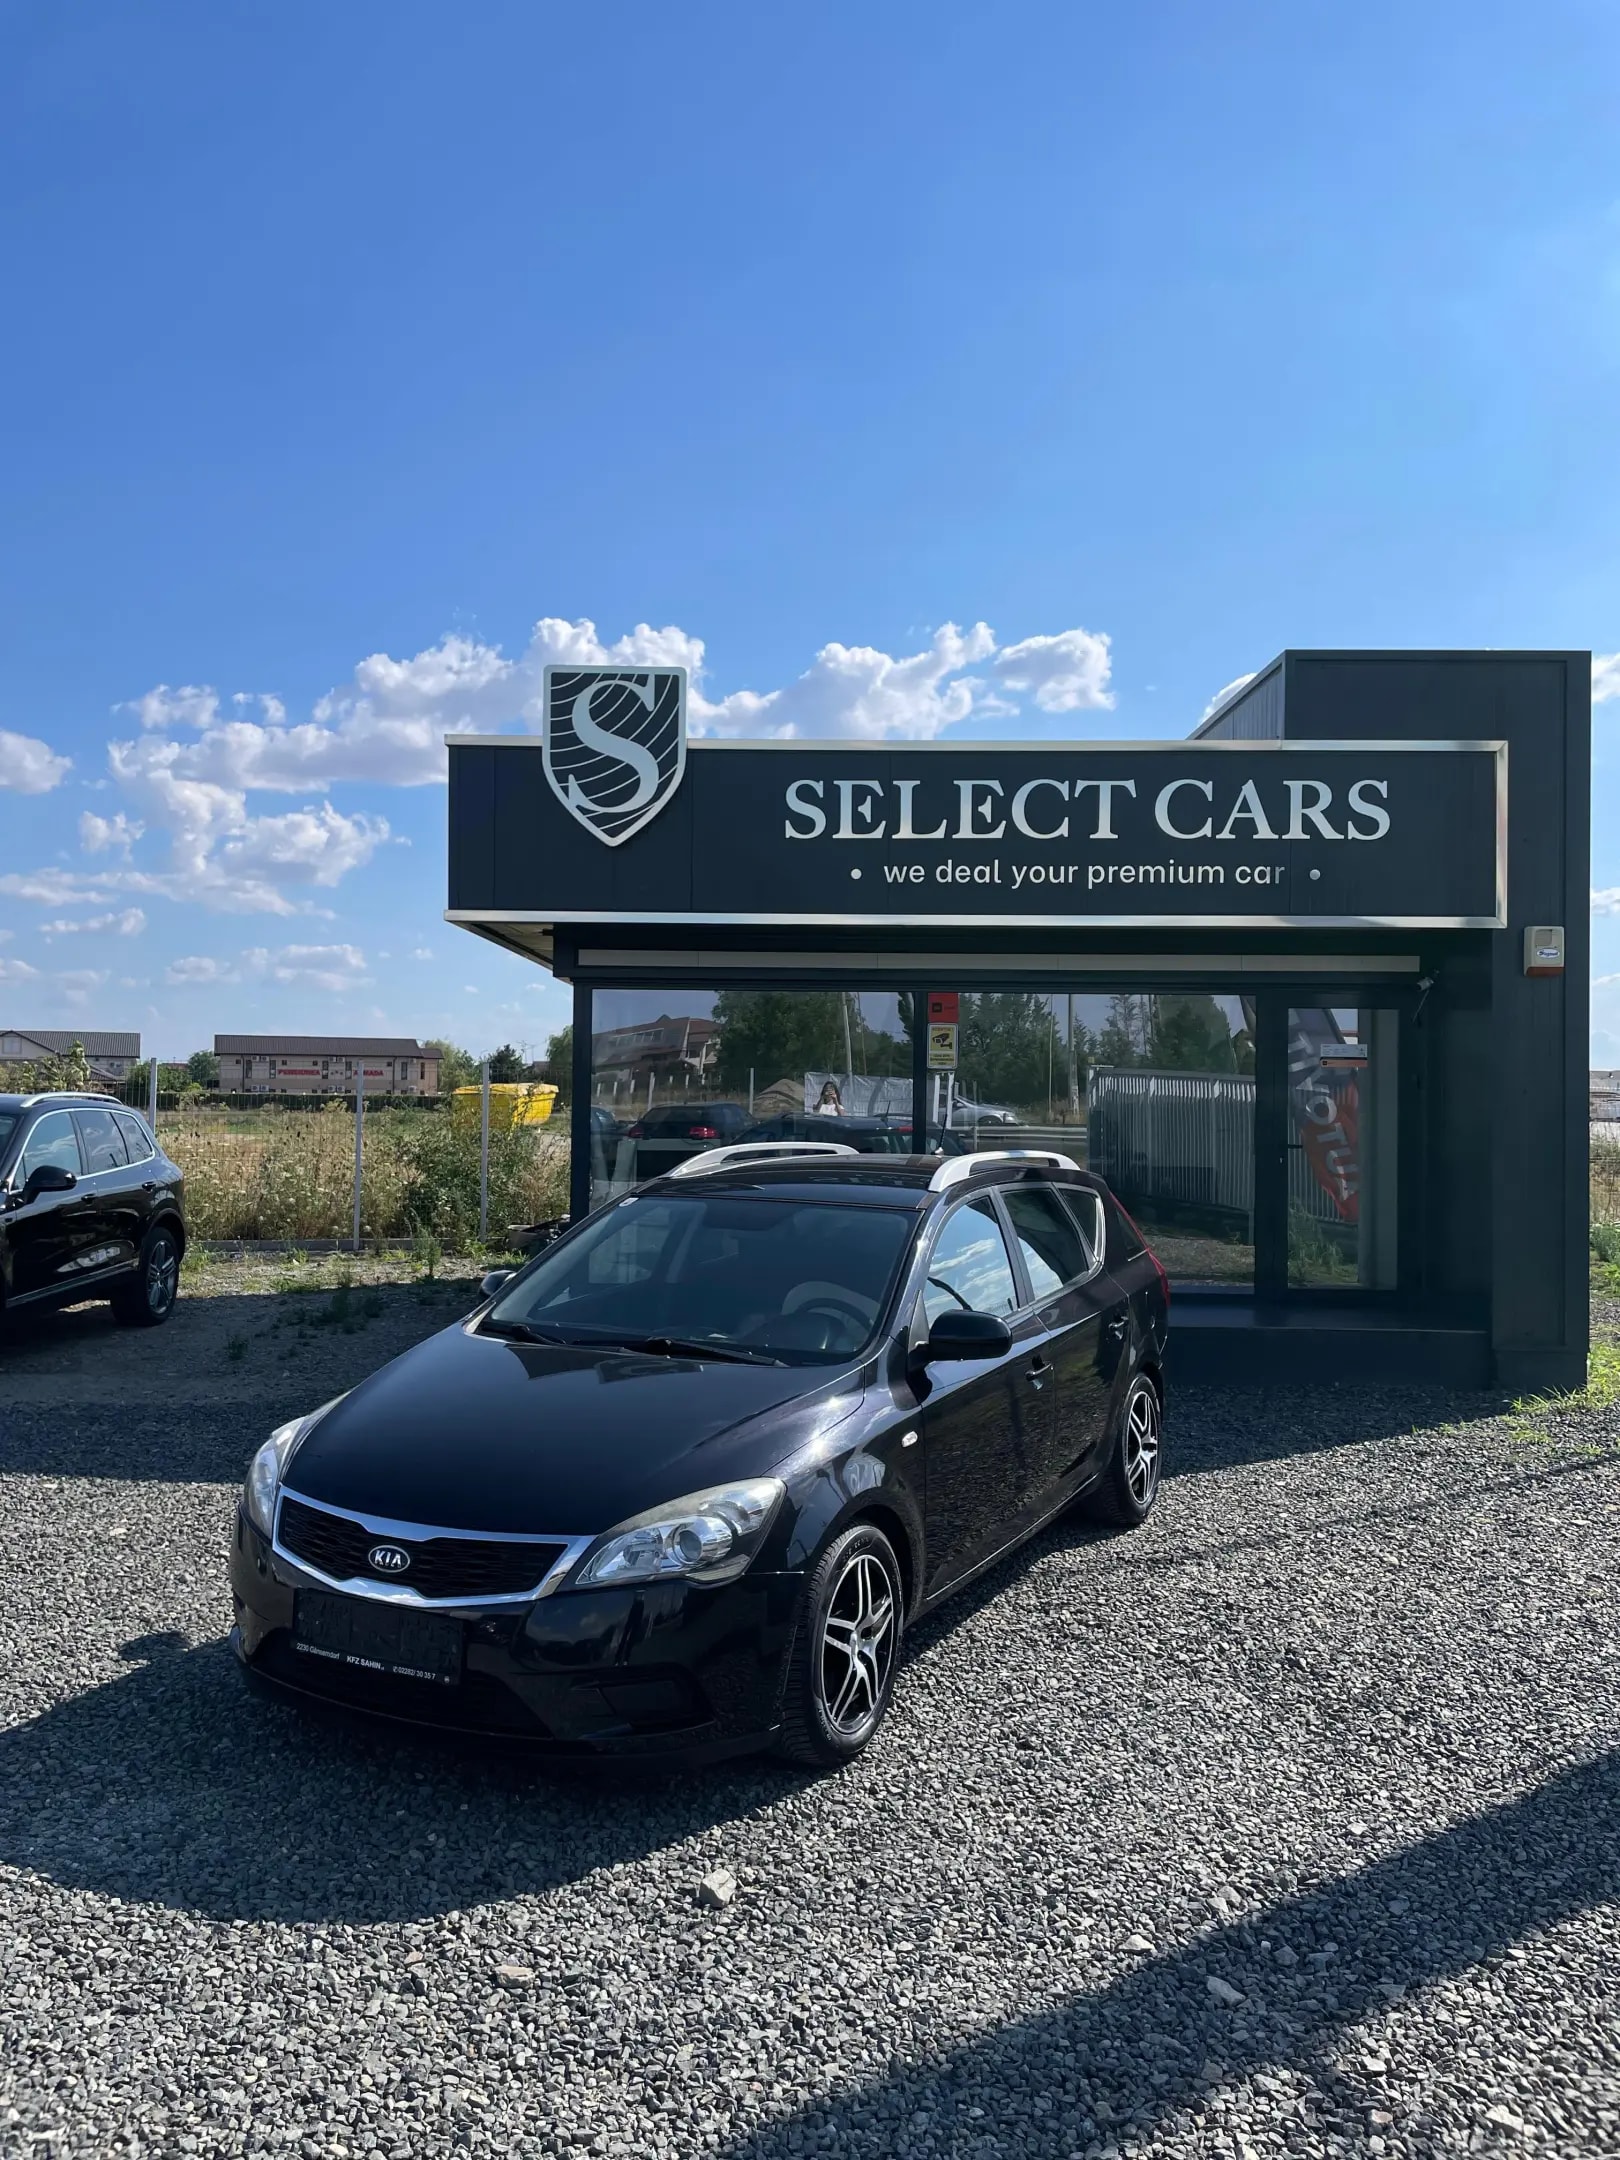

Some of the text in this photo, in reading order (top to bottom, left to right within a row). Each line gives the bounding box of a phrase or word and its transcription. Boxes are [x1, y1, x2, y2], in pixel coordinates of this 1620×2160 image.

[785, 778, 1391, 841] SELECT CARS
[883, 859, 1286, 890] we deal your premium car
[374, 1550, 402, 1569] KIA
[346, 1655, 360, 1665] KFZ
